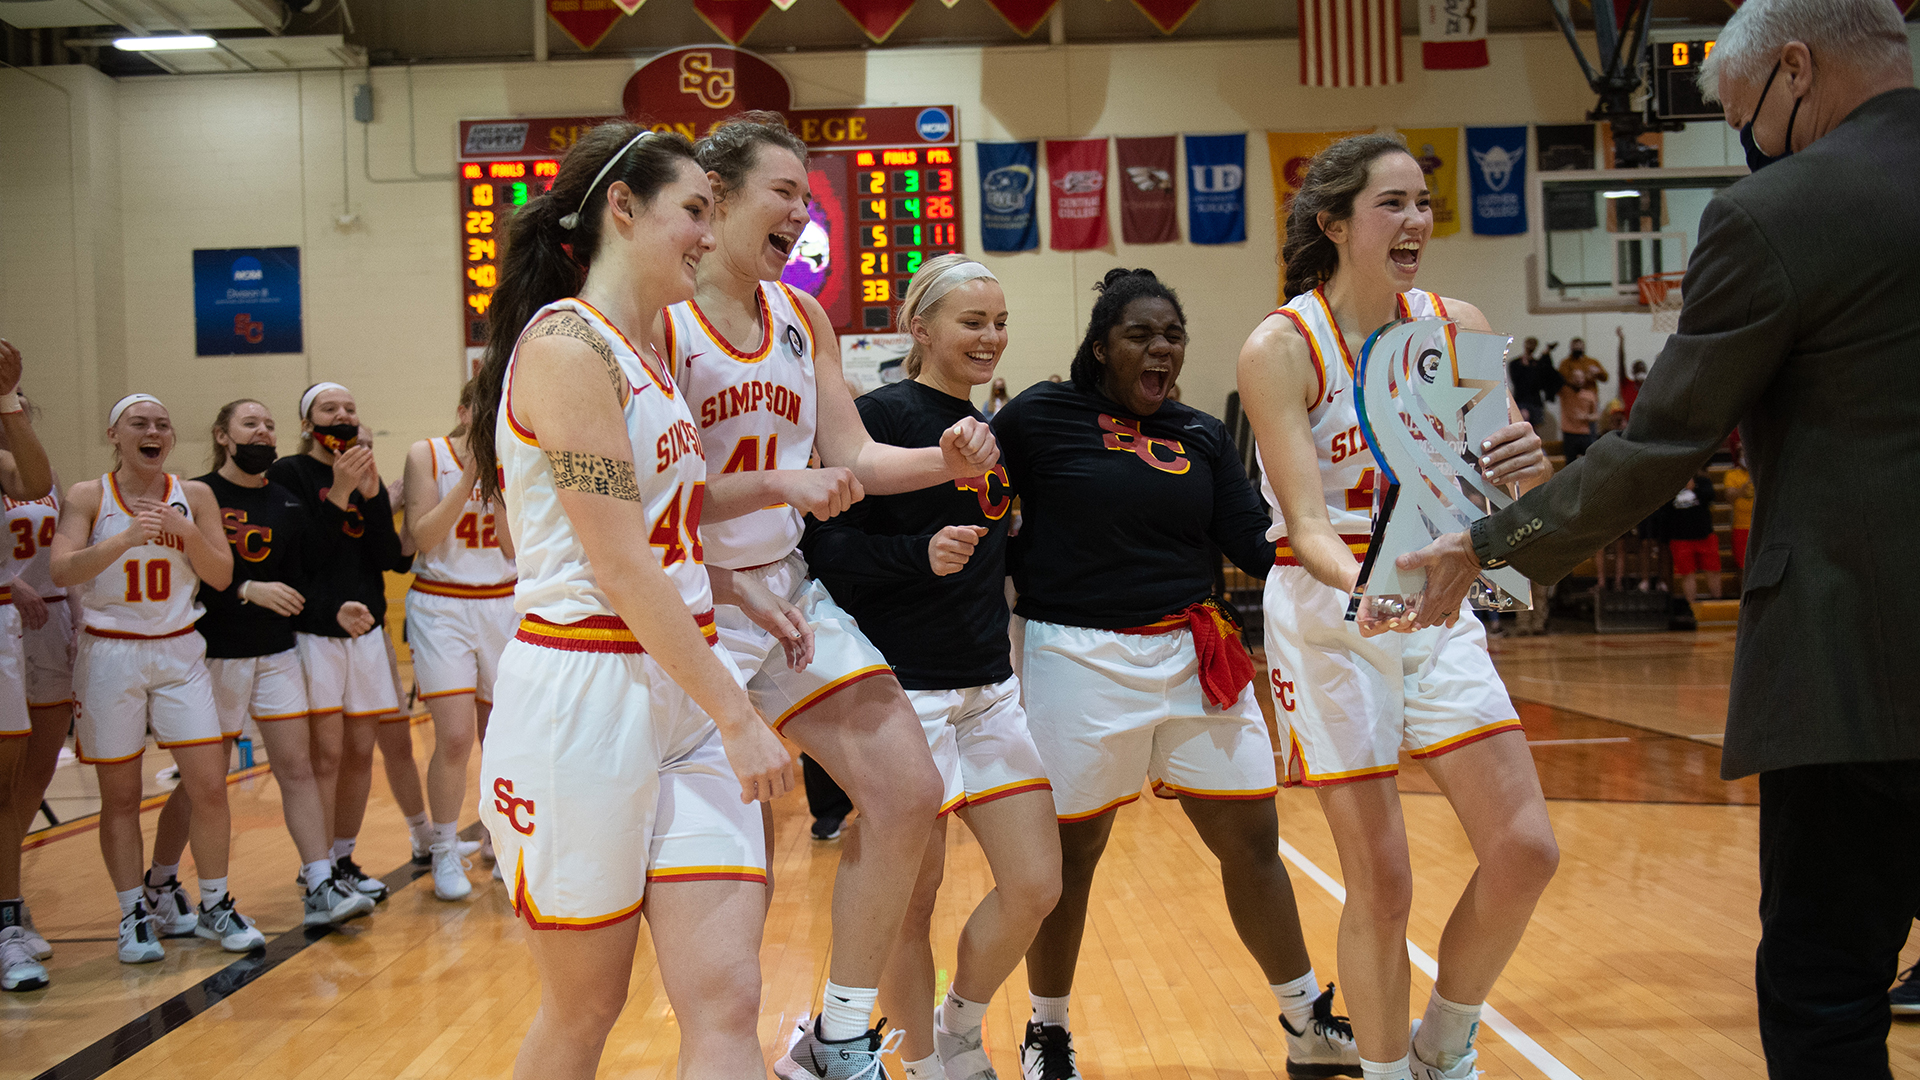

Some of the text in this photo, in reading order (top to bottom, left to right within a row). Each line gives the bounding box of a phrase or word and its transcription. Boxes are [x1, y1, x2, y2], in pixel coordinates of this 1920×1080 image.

[679, 52, 735, 109] SC
[489, 161, 525, 178] FOULS
[856, 148, 953, 167] NO. FOULS PTS.
[870, 168, 954, 194] 2 3 3
[512, 182, 527, 205] 3
[1058, 197, 1100, 208] CENTRAL
[870, 196, 954, 220] 4 4 26
[1058, 207, 1100, 219] COLLEGE
[466, 210, 494, 234] 22
[871, 223, 955, 248] 5 1 11
[467, 238, 496, 261] 34
[860, 251, 922, 275] 21 2
[467, 264, 496, 287] 40
[226, 288, 260, 300] Division
[862, 279, 889, 302] 33
[234, 313, 264, 344] SC
[701, 380, 802, 430] SIMPSON
[10, 516, 56, 560] 34
[221, 507, 272, 563] SC
[455, 512, 501, 549] 42
[123, 558, 171, 603] 10
[1271, 668, 1296, 712] SC
[493, 777, 536, 837] SC
